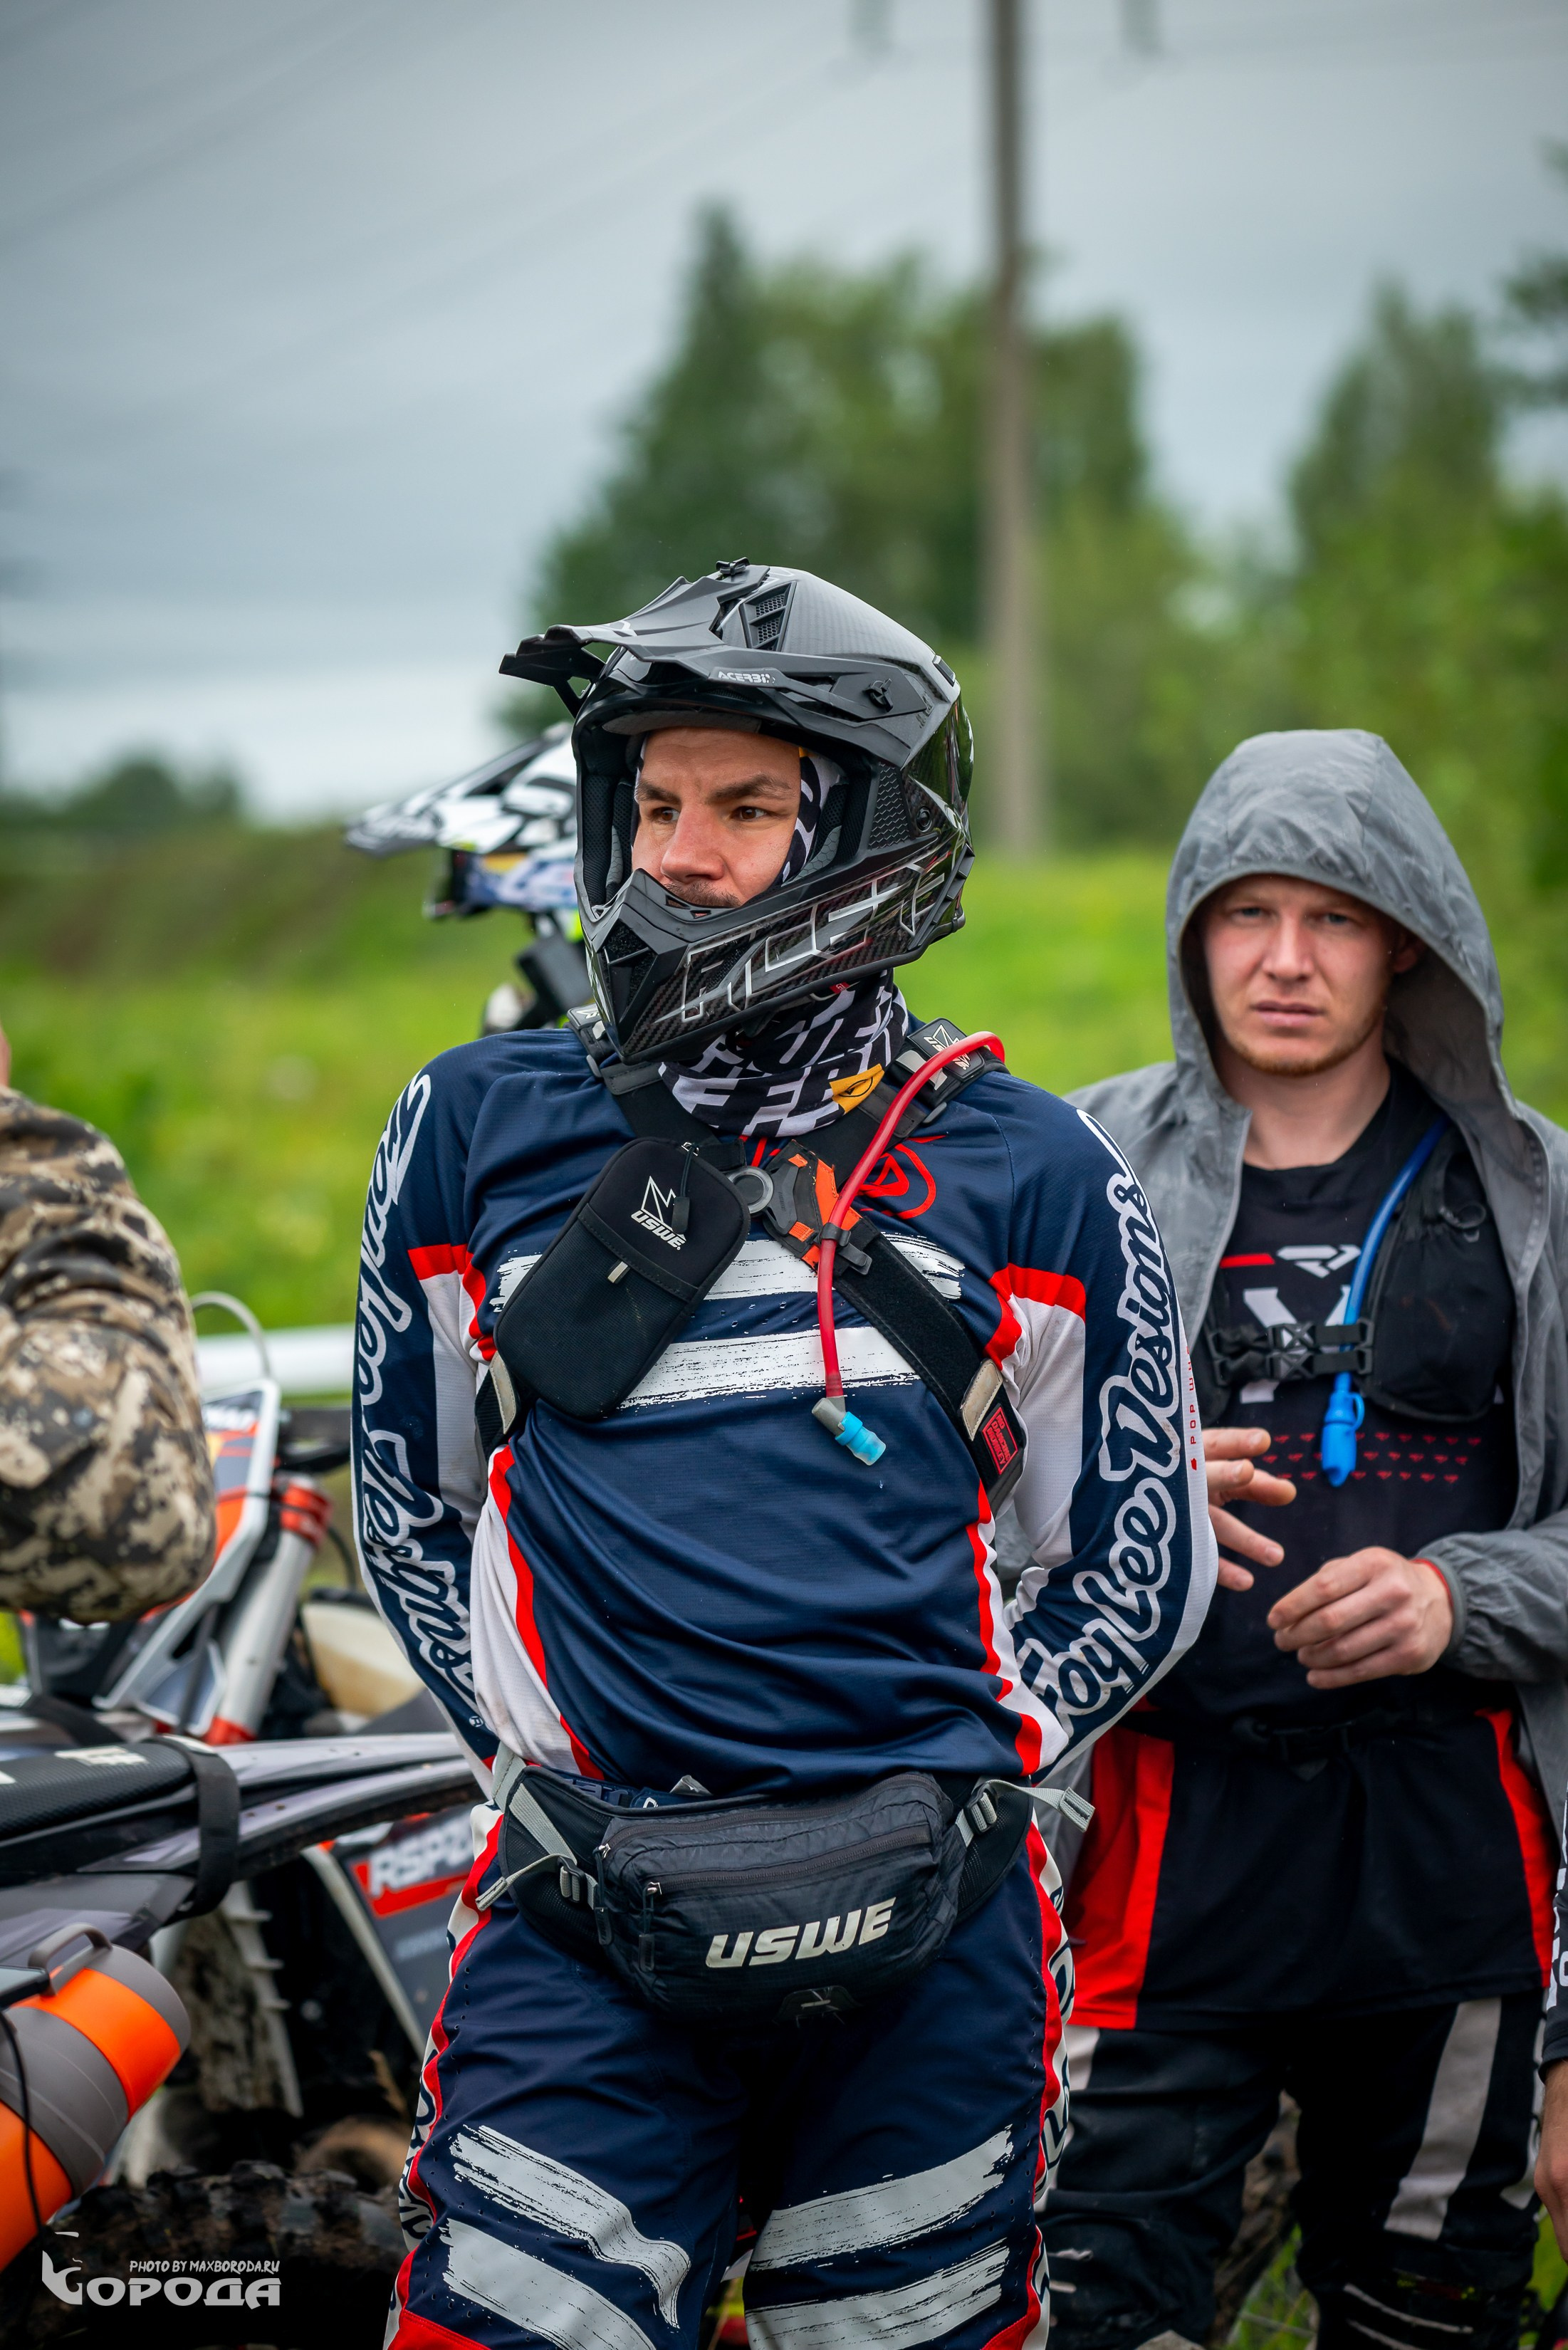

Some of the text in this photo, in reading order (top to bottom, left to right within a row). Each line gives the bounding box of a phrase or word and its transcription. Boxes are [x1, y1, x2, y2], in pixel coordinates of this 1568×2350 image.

[631, 1210, 686, 1248] USWE
[1072, 1478, 1176, 1641] Lee
[705, 1896, 897, 1968] USWE
